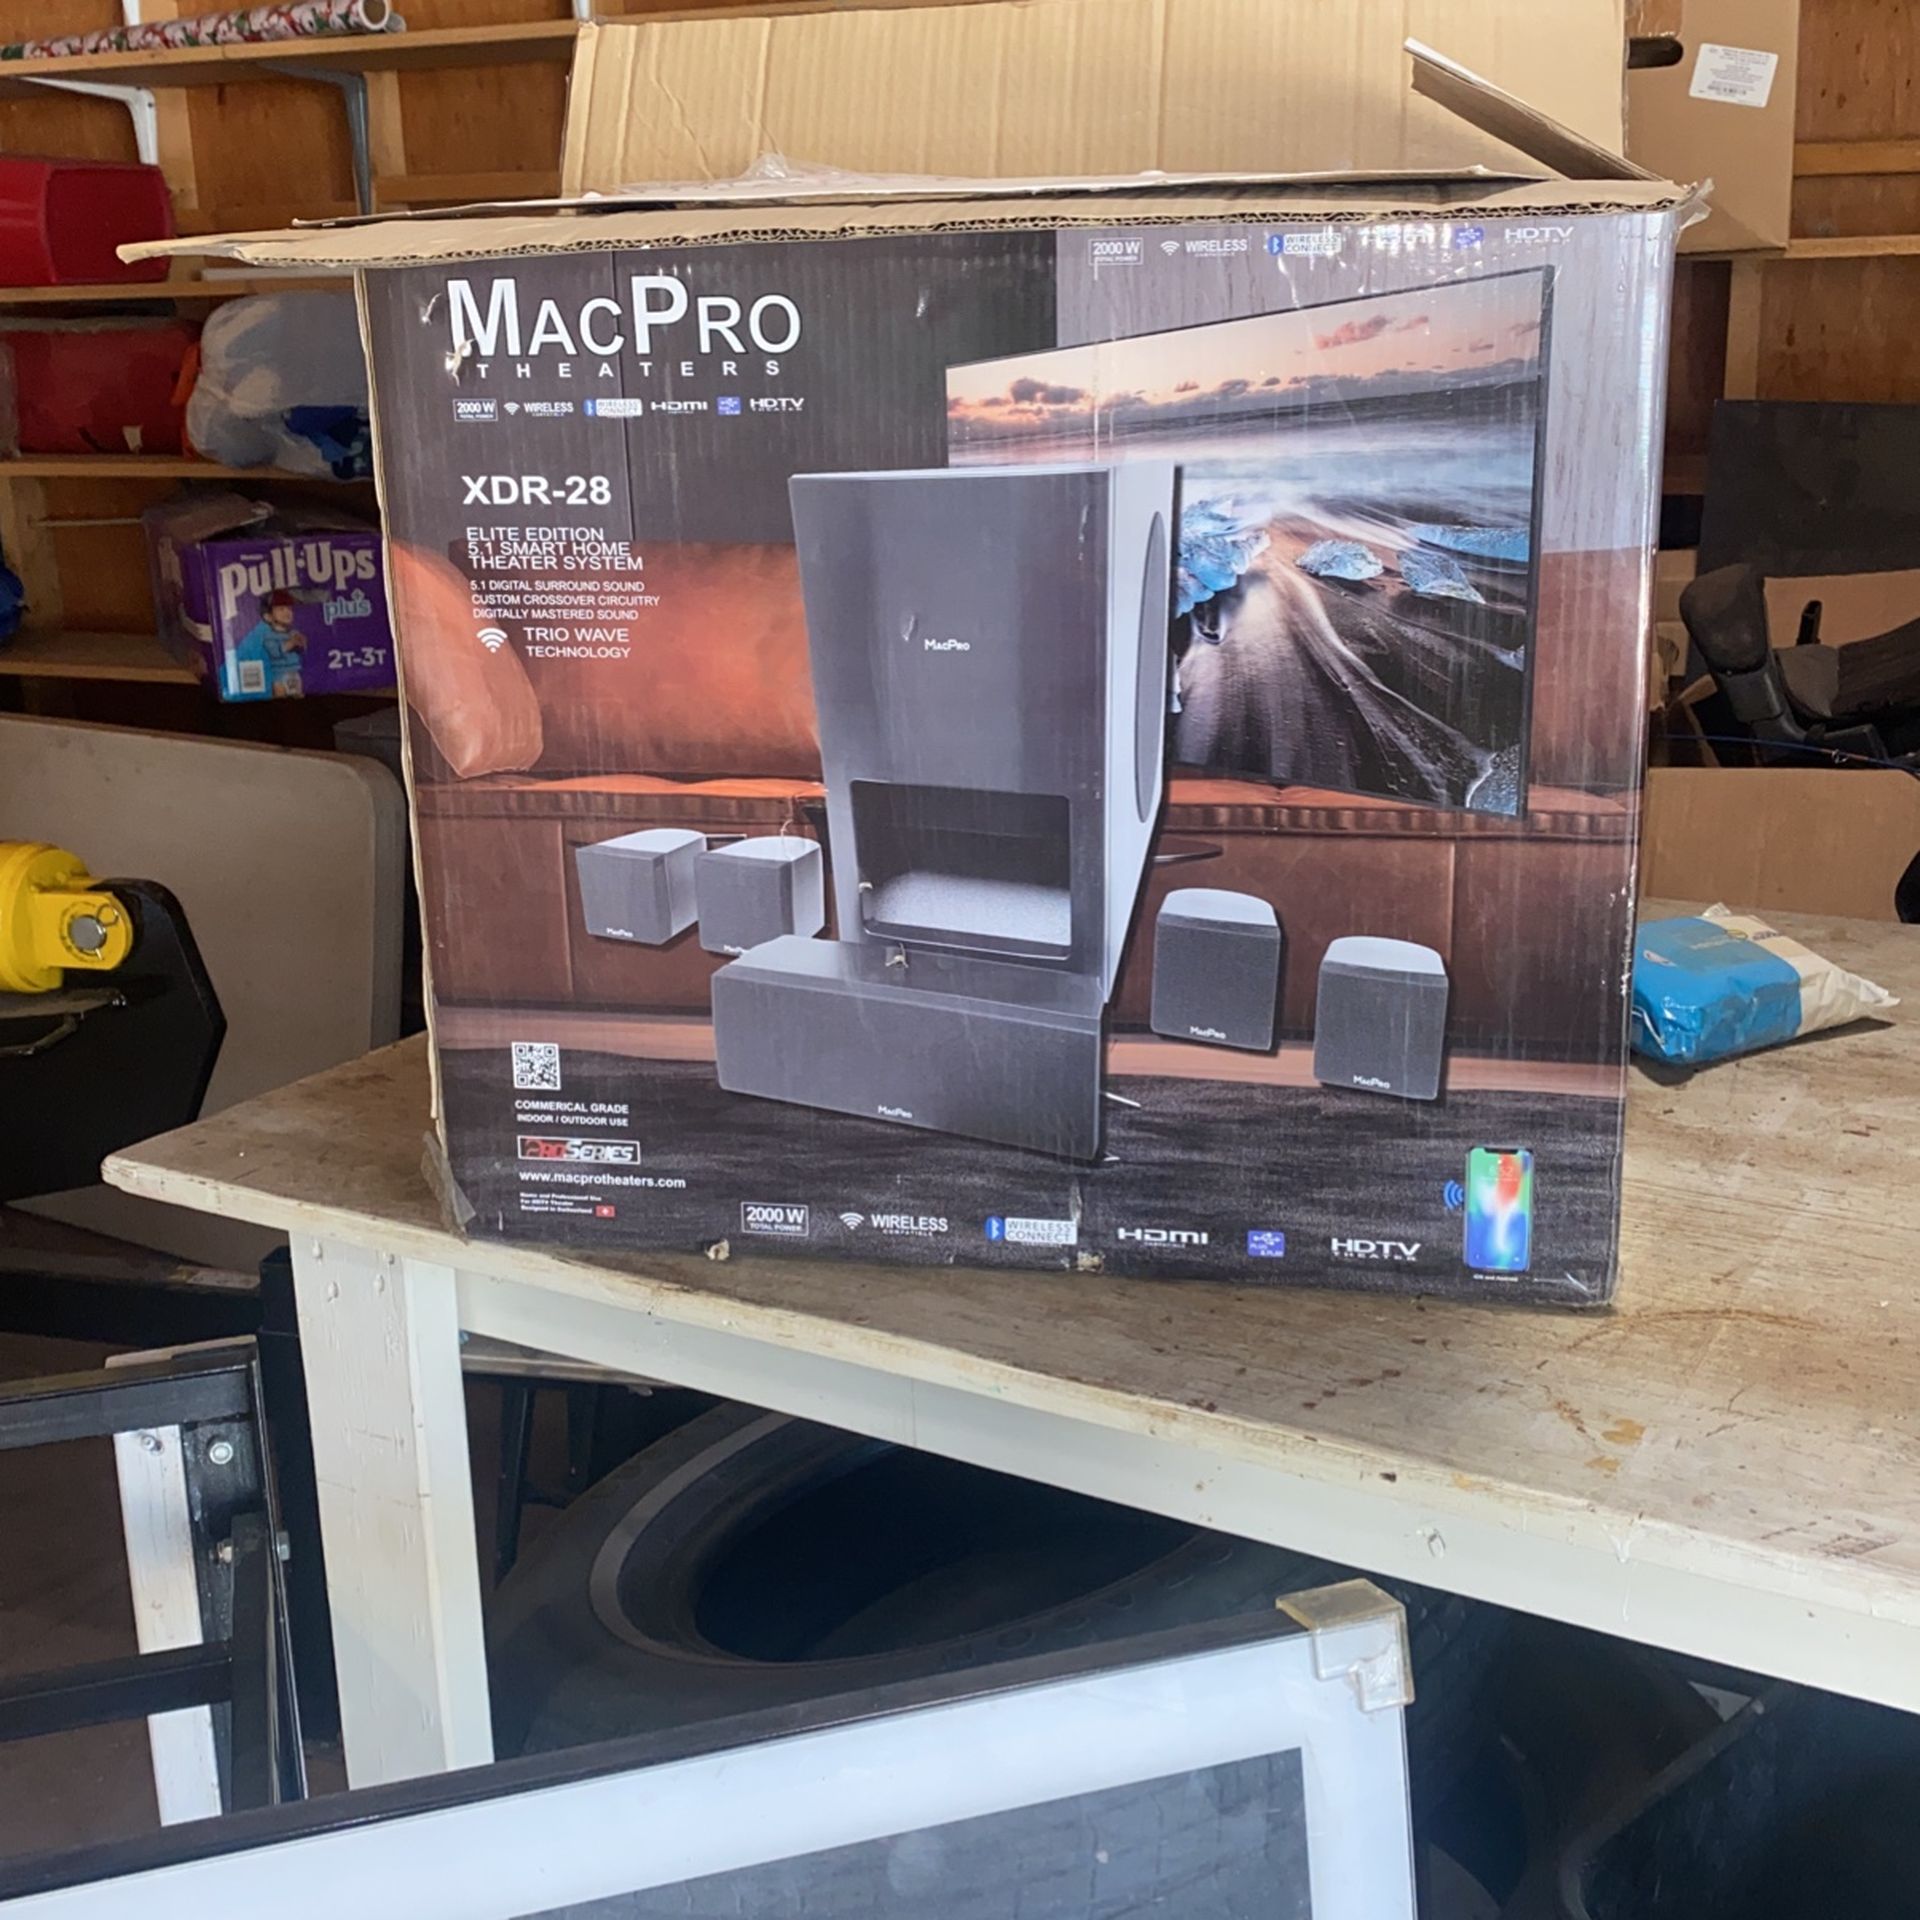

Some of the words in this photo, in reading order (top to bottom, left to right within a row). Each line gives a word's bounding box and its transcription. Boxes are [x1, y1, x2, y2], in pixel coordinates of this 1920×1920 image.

[1505, 226, 1574, 239] HDTV
[1092, 241, 1123, 255] 2000
[1125, 240, 1141, 254] W
[1185, 238, 1248, 253] WIRELESS
[476, 360, 780, 379] THEATERS
[457, 402, 482, 413] 2000
[483, 401, 496, 413] W
[523, 402, 574, 413] WIRELESS
[651, 401, 708, 411] HDMI
[750, 397, 805, 408] HDTV
[461, 475, 612, 505] XDR-28
[466, 526, 520, 541] ELITE
[525, 527, 604, 542] EDITION
[468, 541, 494, 556] 5.1
[500, 541, 568, 556] SMART
[572, 542, 631, 557] HOME
[469, 555, 558, 570] THEATER
[563, 556, 644, 571] SYSTEM
[470, 580, 486, 591] 5.1
[489, 580, 532, 591] DIGITAL
[535, 580, 600, 592] SURROUND
[602, 581, 645, 592] SOUND
[471, 594, 521, 605] CUSTOM
[523, 595, 596, 606] CROSSOVER
[598, 596, 660, 607] CIRCUITRY
[473, 608, 528, 619] DIGITALLY
[531, 609, 594, 620] MASTERED
[596, 609, 639, 621] SOUND
[523, 627, 569, 642] TRIO
[574, 627, 630, 643] WAVE
[327, 647, 387, 669] 2T-3T
[526, 645, 631, 659] TECHNOLOGY
[514, 1099, 588, 1113] COMMERICAL
[591, 1103, 630, 1114] GRADE
[516, 1114, 554, 1123] INDOOR
[560, 1115, 608, 1126] OUTDOOR
[609, 1117, 629, 1127] USE
[519, 1170, 687, 1190] www.macprotheaters.com
[746, 1206, 784, 1222] 2000
[786, 1208, 805, 1224] W
[870, 1213, 949, 1232] WIRELESS
[1007, 1219, 1073, 1232] WIRELESS
[1006, 1230, 1071, 1242] CONNECT
[1117, 1227, 1209, 1245] HDMI
[1331, 1237, 1422, 1256] HDTV
